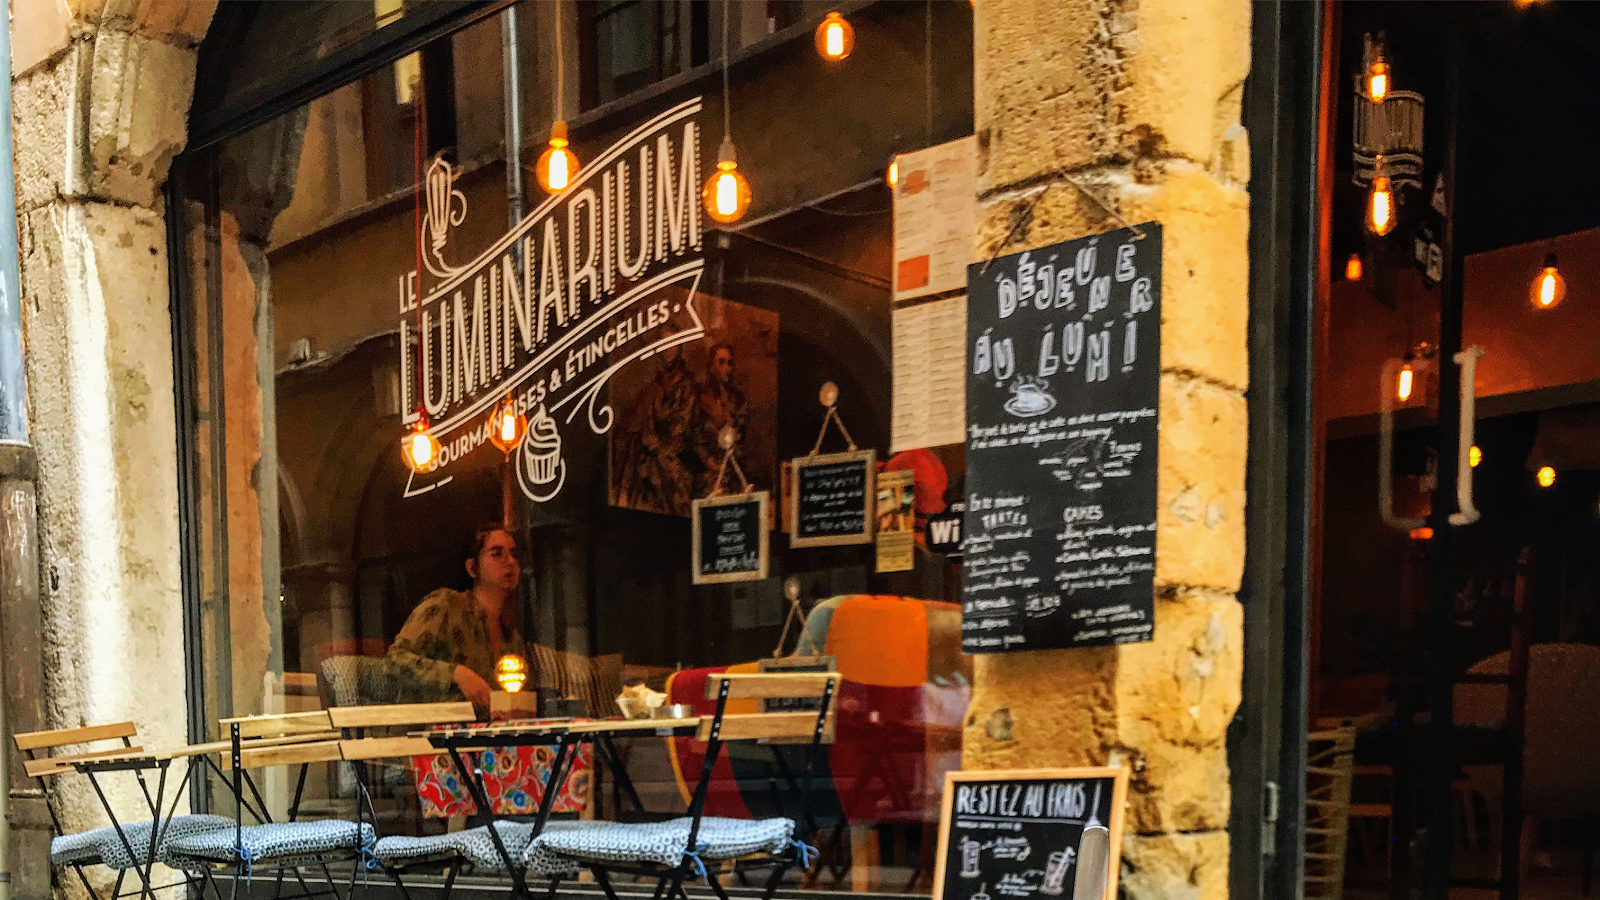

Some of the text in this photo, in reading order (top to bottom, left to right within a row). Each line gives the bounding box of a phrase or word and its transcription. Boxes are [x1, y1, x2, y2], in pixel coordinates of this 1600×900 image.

[399, 270, 418, 315] LE
[400, 121, 702, 429] LUMINARIUM
[996, 238, 1154, 319] DÉJEUNER
[428, 300, 670, 472] GOURMANISES & ÉTINCELLES
[973, 327, 1016, 382] AU
[957, 783, 1023, 816] RESTEZ
[1022, 783, 1045, 818] AU
